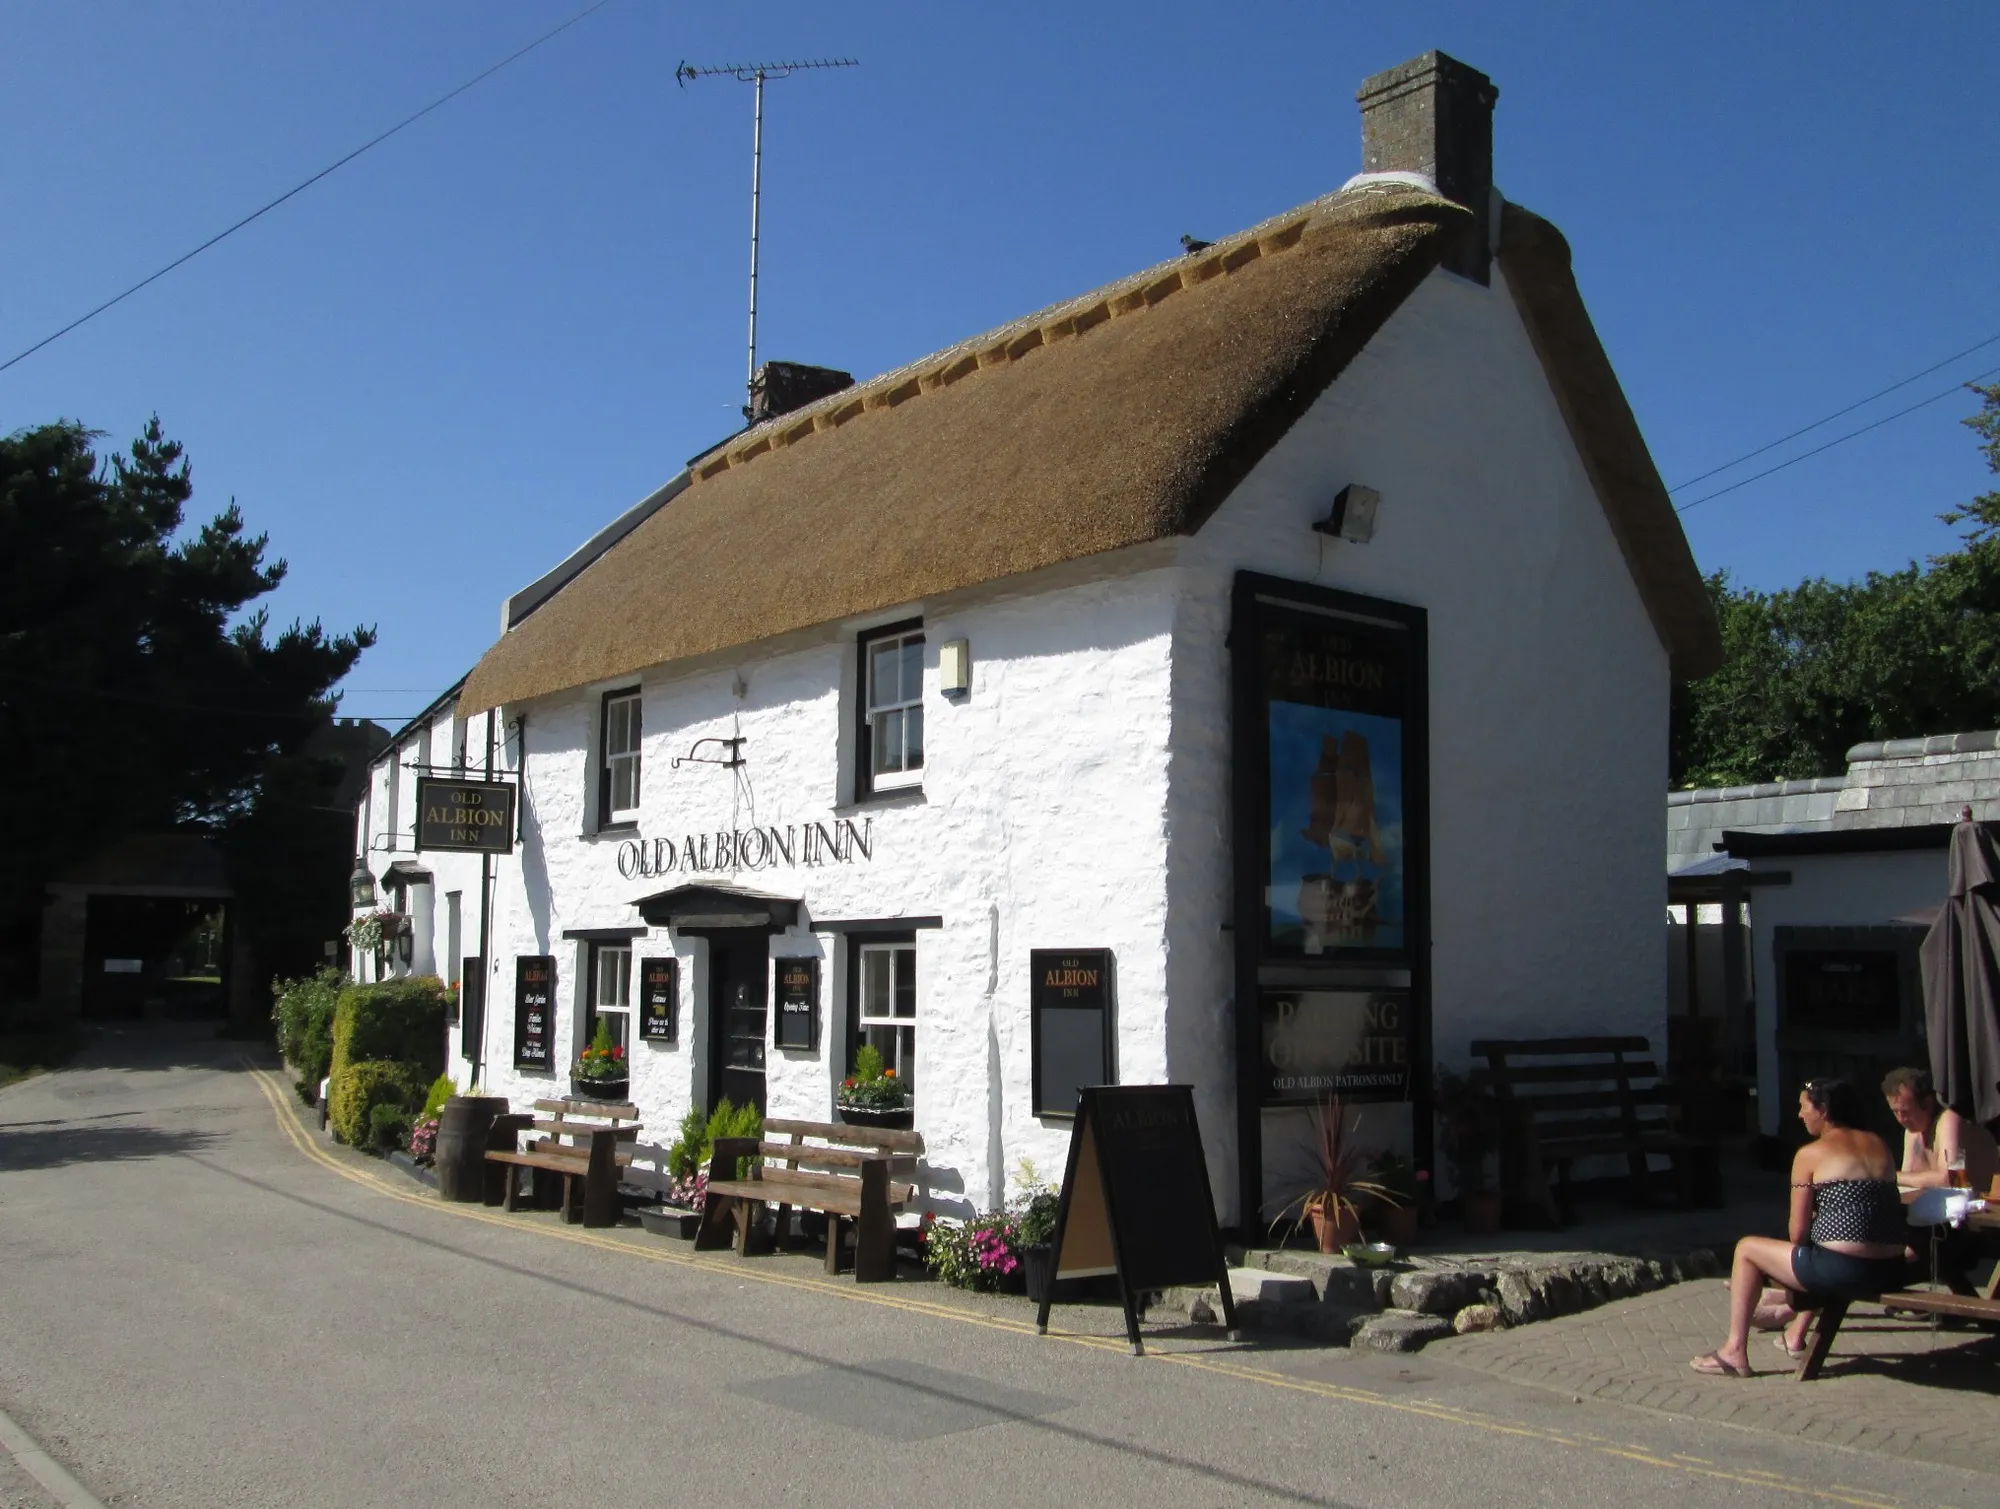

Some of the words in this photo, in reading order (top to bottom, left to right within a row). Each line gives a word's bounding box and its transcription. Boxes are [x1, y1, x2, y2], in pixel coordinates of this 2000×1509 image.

[1290, 650, 1384, 690] ALBION
[451, 791, 482, 805] OLD
[426, 806, 504, 827] ALBION
[450, 829, 480, 842] INN
[618, 837, 675, 877] OLD
[680, 825, 794, 871] ALBION
[803, 817, 872, 863] INN
[1062, 959, 1079, 967] OLD
[648, 972, 669, 983] ALBION
[783, 974, 810, 985] ALBION
[1045, 969, 1098, 986] ALBION
[1063, 988, 1079, 998] INN
[1277, 1001, 1398, 1030] PANG
[1269, 1036, 1406, 1069] OSITE
[1273, 1077, 1296, 1090] OLD
[1297, 1075, 1333, 1089] ALBION
[1335, 1074, 1378, 1088] PATRONS
[1378, 1073, 1404, 1086] ONLY
